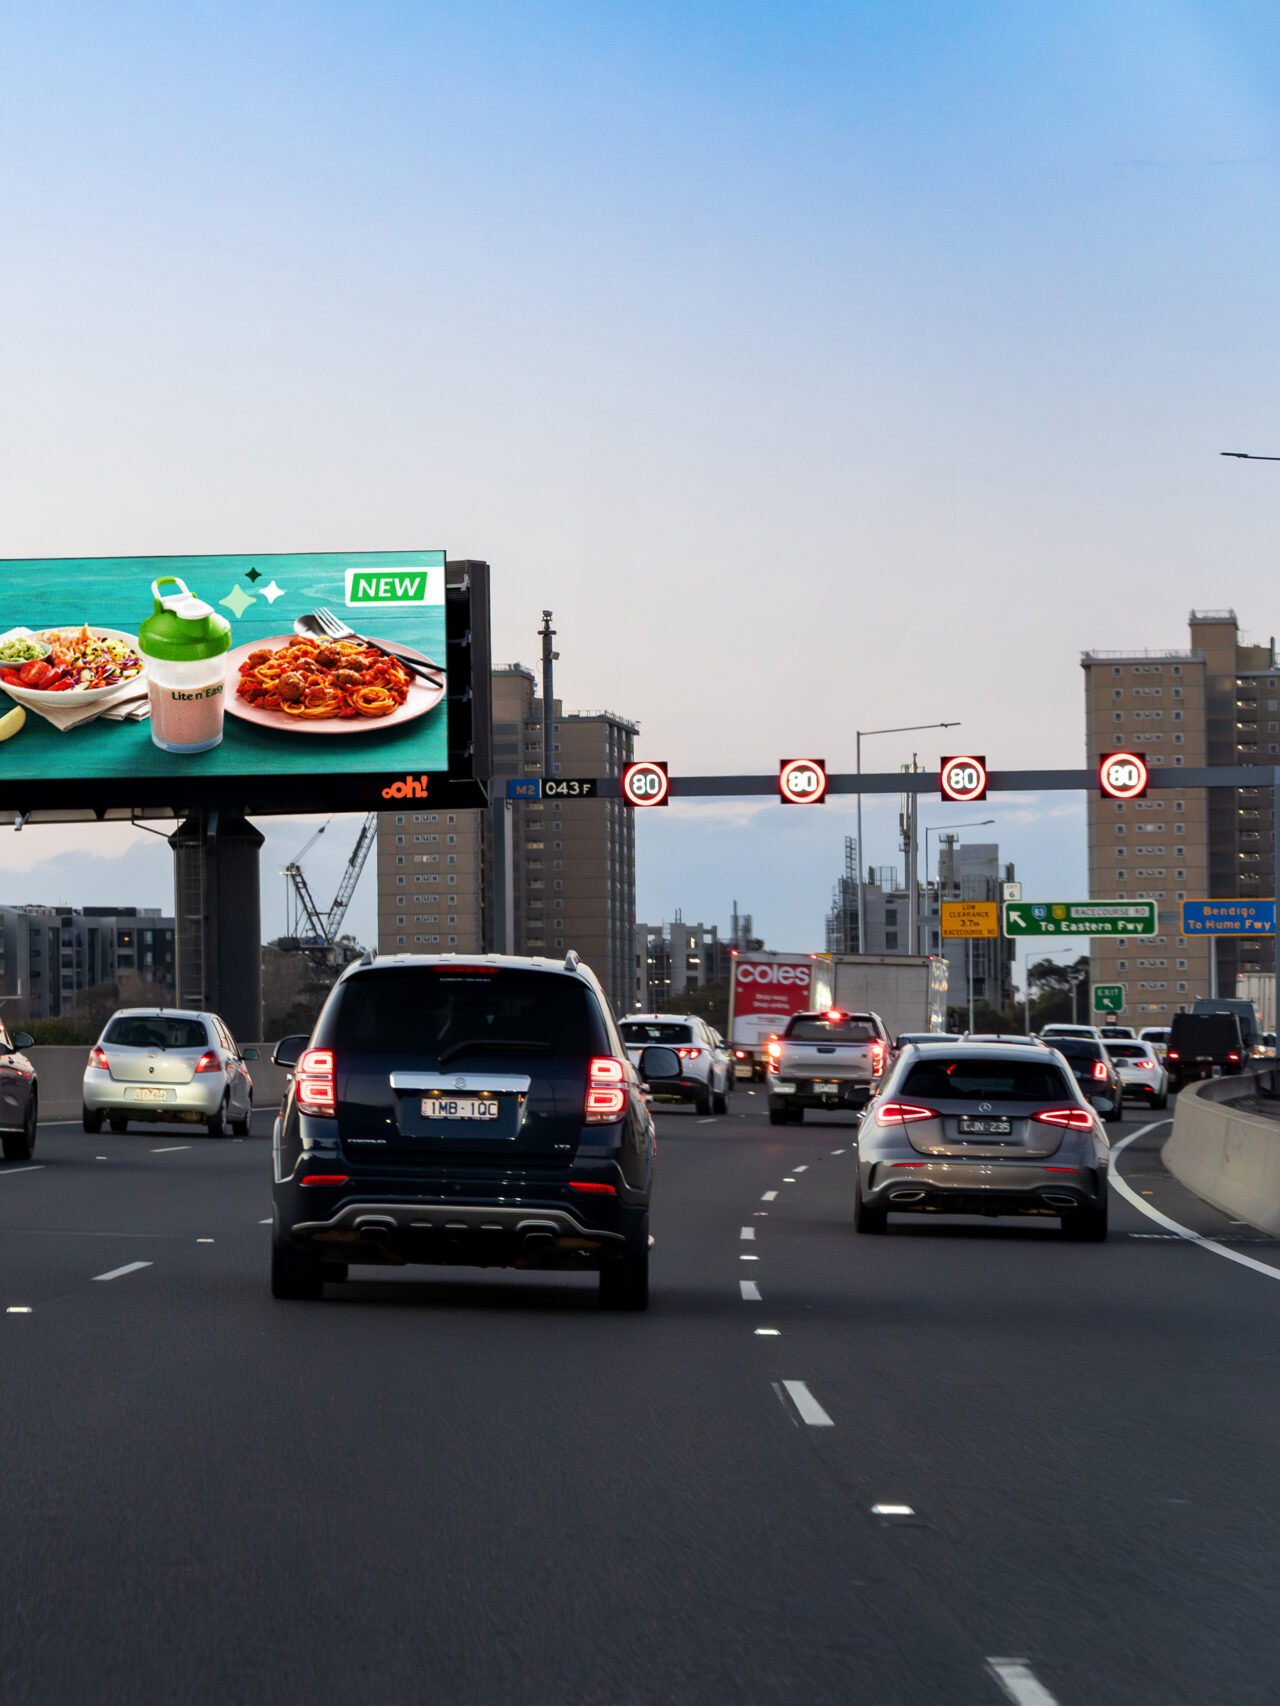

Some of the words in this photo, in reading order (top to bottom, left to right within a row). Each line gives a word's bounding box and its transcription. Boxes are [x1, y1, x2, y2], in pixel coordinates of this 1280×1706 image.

[358, 577, 421, 598] NEW
[171, 691, 193, 701] Lite
[788, 771, 817, 791] 80
[951, 768, 977, 789] 80
[1109, 765, 1138, 786] 80
[516, 785, 536, 795] M2
[632, 774, 659, 795] 80
[1203, 906, 1256, 918] Bendigo
[1040, 922, 1055, 931] To
[1061, 921, 1112, 931] Eastern
[1118, 920, 1144, 933] Fwy
[1187, 919, 1202, 929] To
[1205, 920, 1241, 929] Hume
[1245, 919, 1271, 931] Fwy
[737, 964, 809, 985] coles
[1097, 988, 1119, 996] EXIT
